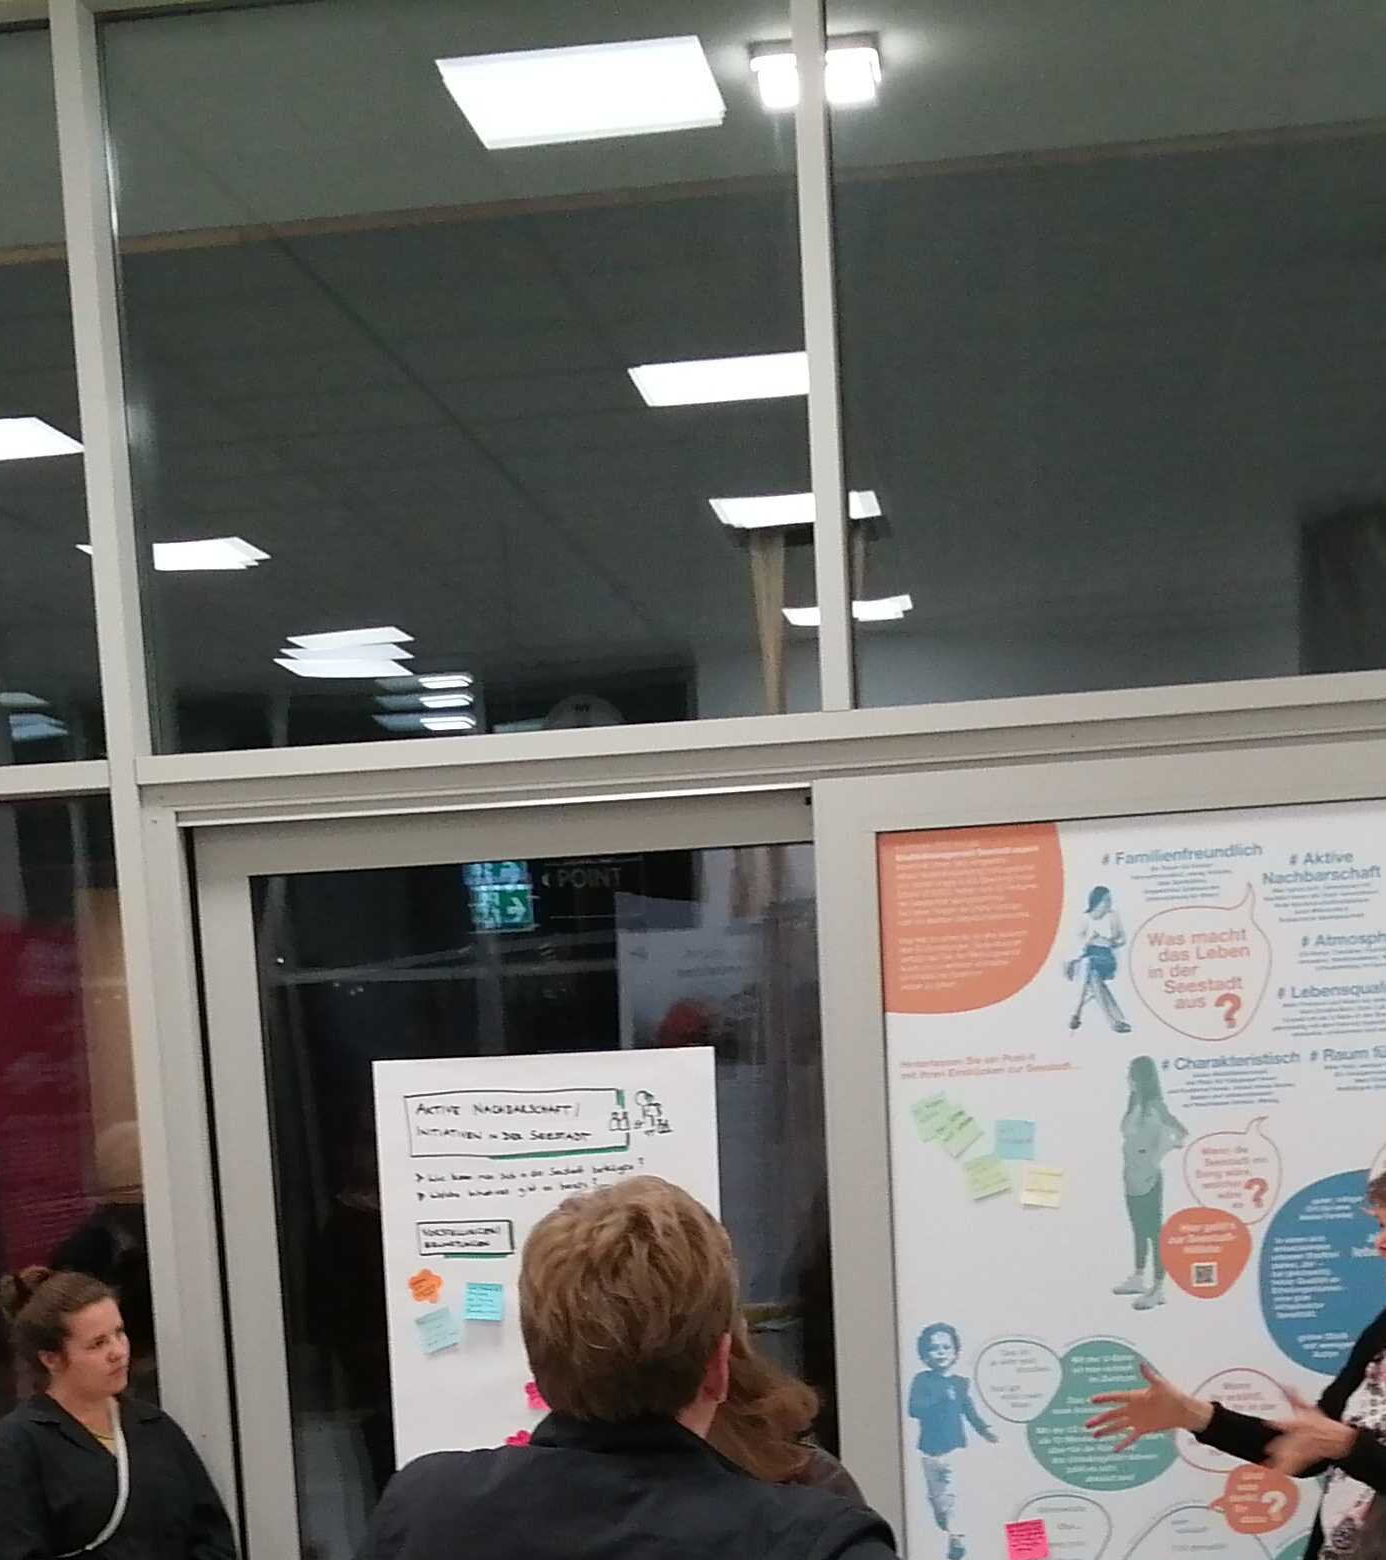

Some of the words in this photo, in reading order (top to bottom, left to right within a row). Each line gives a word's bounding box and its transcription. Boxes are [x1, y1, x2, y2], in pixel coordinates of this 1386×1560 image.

[1116, 843, 1263, 865] Familienfreundlich
[1303, 852, 1354, 865] Aktive
[558, 867, 622, 889] POINT
[1262, 865, 1382, 885] Nachbarschaft
[1147, 932, 1186, 947] Was
[1191, 929, 1248, 945] macht
[1158, 949, 1190, 962] das
[1196, 945, 1250, 960] Leben
[1148, 965, 1163, 978] in
[1169, 964, 1199, 978] der
[1164, 976, 1244, 994] Seestadt
[1174, 997, 1207, 1009] aus
[1214, 993, 1242, 1028] ?
[1174, 1051, 1301, 1070] Charakteristisch
[1324, 1048, 1369, 1061] Raum
[416, 1102, 461, 1116] AKTIVE
[1244, 1177, 1269, 1208] ?
